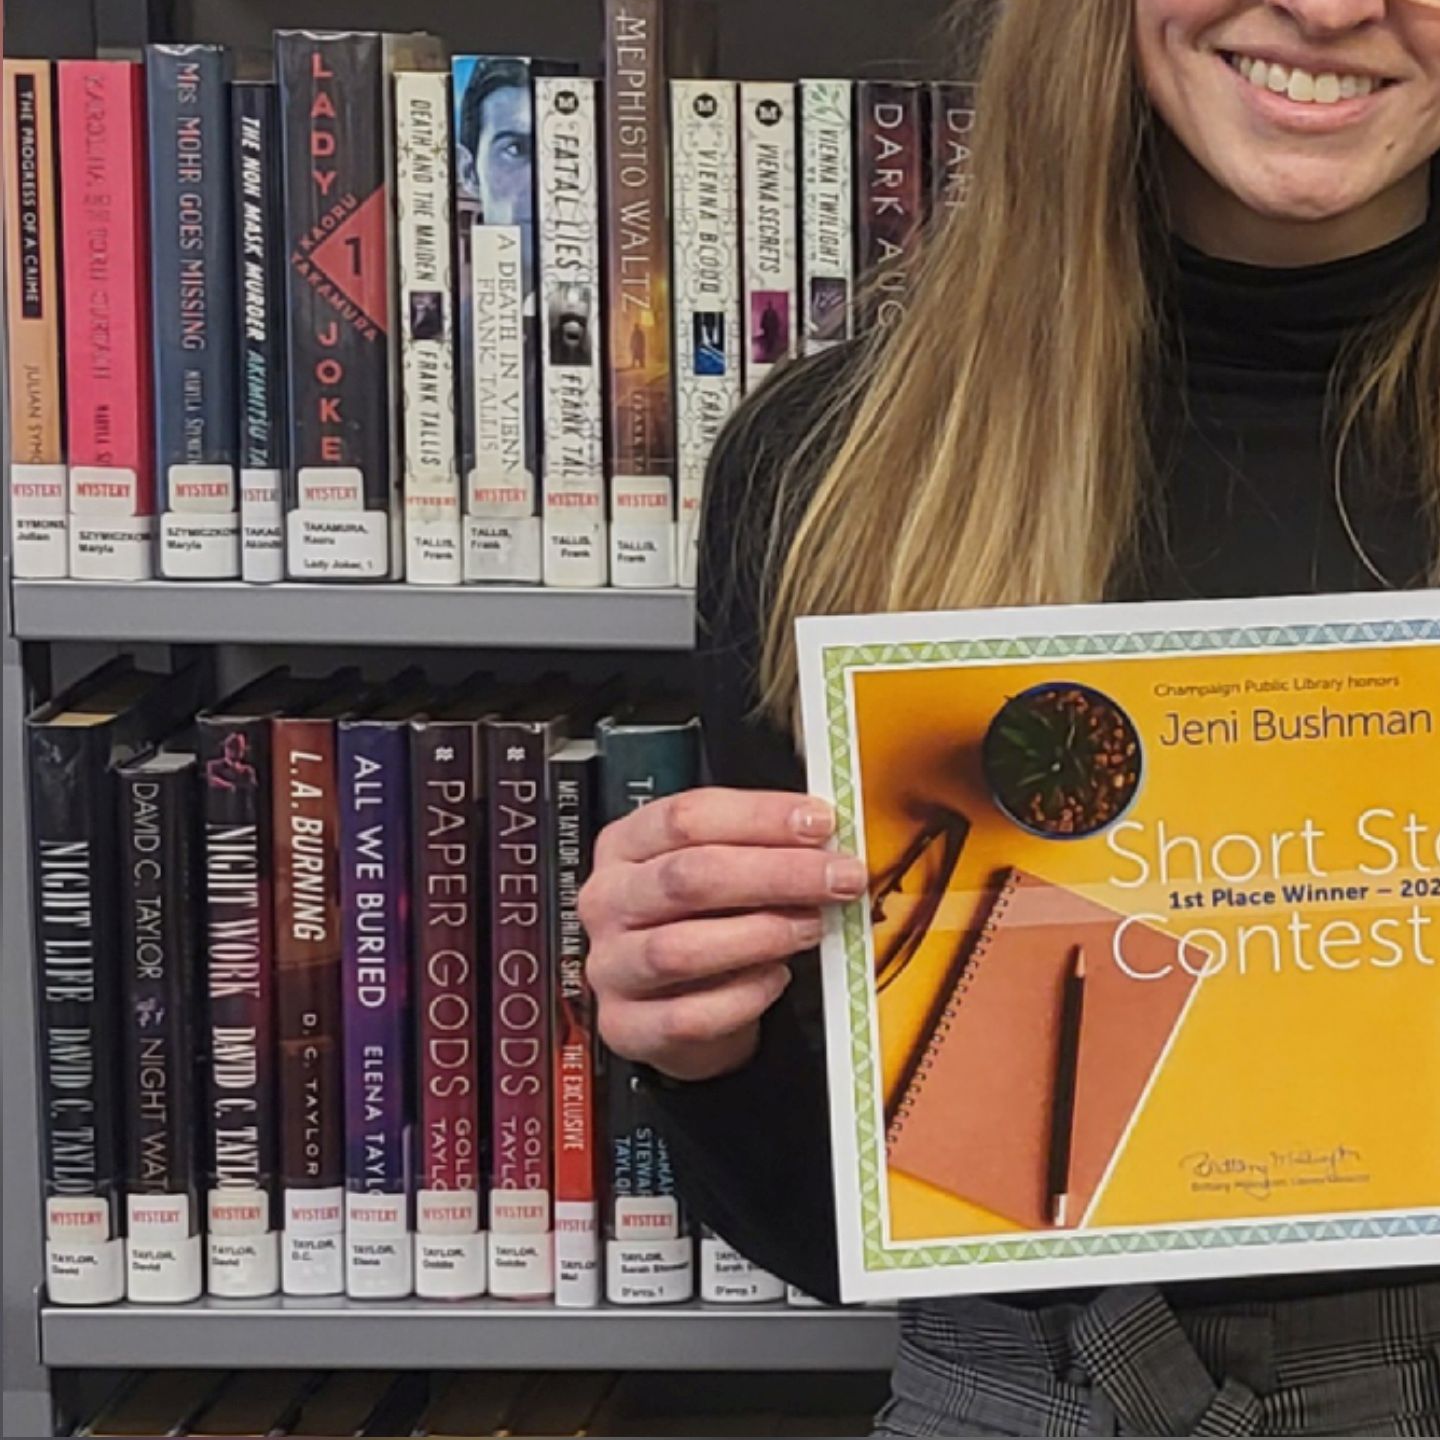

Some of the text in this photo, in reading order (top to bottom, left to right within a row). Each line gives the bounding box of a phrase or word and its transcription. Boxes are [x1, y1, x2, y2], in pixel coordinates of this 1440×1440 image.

[311, 53, 338, 195] LADY
[615, 12, 652, 309] MEPHISTO WALTZ
[22, 91, 42, 302] THE PROGRESS OF A CRIME
[179, 63, 208, 351] MRS MOHR GOES MISSING
[553, 134, 582, 272] FATAL LIES
[699, 151, 720, 294] VIENNA BLOOD
[760, 143, 782, 274] VIENNA SECRETS
[247, 263, 268, 341] MURDER
[419, 349, 442, 467] FRANK TALLIS
[1154, 674, 1401, 699] Champaign Public Library honors
[1160, 705, 1433, 747] Jeni Bushman
[208, 823, 264, 998] NIGHT WORK
[291, 750, 328, 941] L.A. BURNING
[355, 756, 388, 1008] ALL WE BURIED
[1107, 817, 1328, 889] Short
[1168, 889, 1202, 911] 1st
[1208, 886, 1276, 908] Place
[1282, 882, 1369, 904] Winner
[42, 840, 97, 1001] NIGHT LIFE
[428, 781, 470, 1098] PAPER GODS
[1112, 905, 1436, 980] Contest
[562, 1044, 586, 1150] THE EXCLUSIVE
[51, 1211, 103, 1226] MYSTERY
[53, 1265, 81, 1275] David
